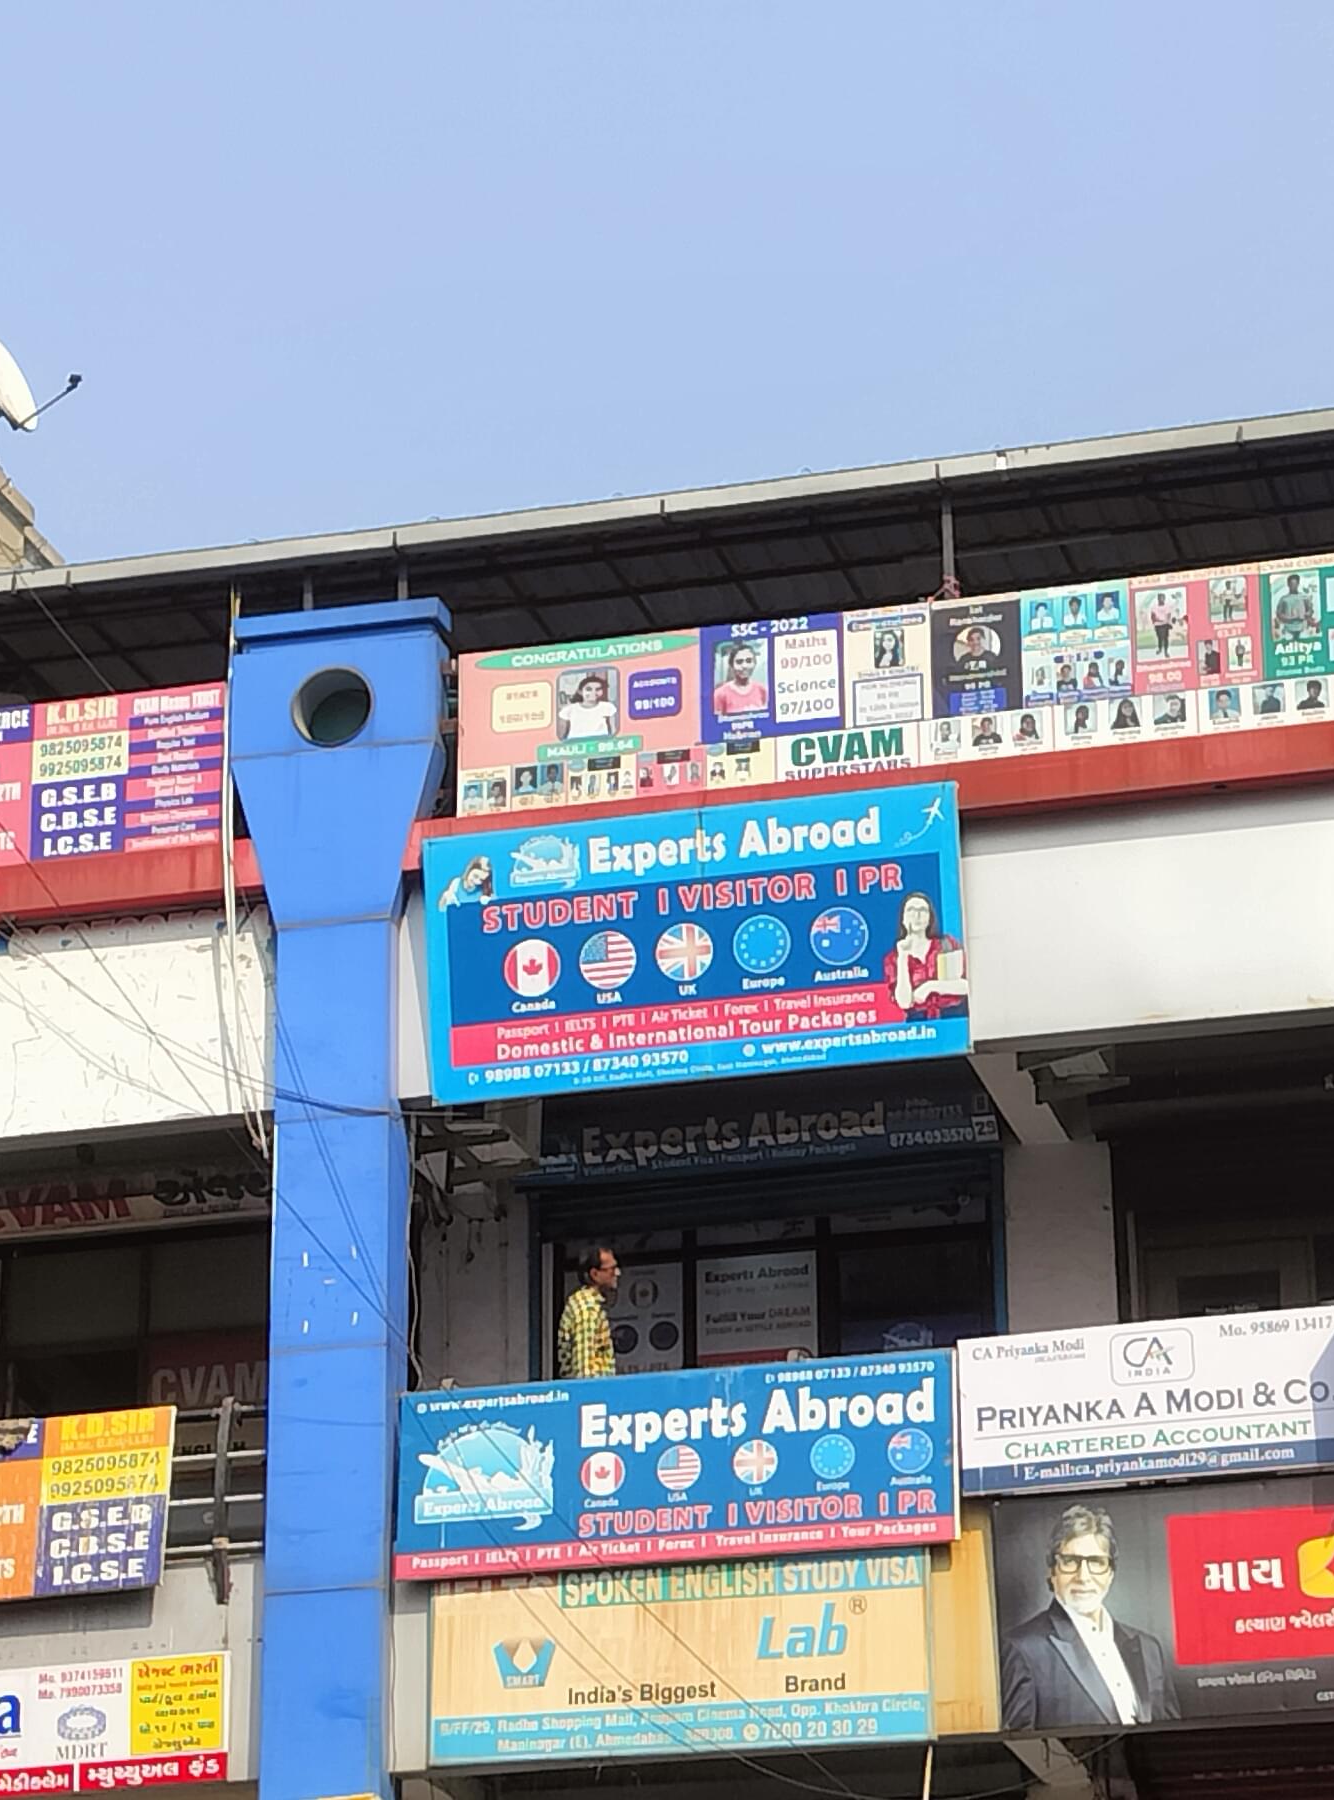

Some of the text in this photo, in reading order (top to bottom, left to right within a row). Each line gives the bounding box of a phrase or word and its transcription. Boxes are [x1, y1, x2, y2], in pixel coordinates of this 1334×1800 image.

[511, 640, 663, 668] CONGRATULATIONS
[785, 636, 827, 650] Maths
[1274, 641, 1322, 656] Aditya
[777, 678, 836, 694] Science
[780, 699, 834, 715] 97/100
[791, 728, 904, 766] CVAM
[785, 759, 911, 781] SUPERSTARS
[41, 782, 117, 807] G.S.E.B
[40, 807, 117, 832] C.B.S.E
[43, 832, 112, 857] I.C.S.E
[589, 807, 881, 877] Experts Abroad
[482, 891, 638, 933] STUDENT
[678, 869, 814, 912] VISITOR
[857, 864, 904, 893] PR
[742, 976, 785, 992] Europe
[815, 967, 869, 983] Australia
[596, 991, 623, 1005] USA
[678, 984, 697, 997] UK
[511, 999, 556, 1014] Canada
[497, 1008, 877, 1060] Domestic & International Tour Packages
[761, 1025, 937, 1058] www.expertsabroad.in
[582, 1115, 741, 1166] Experts
[749, 1101, 886, 1148] Abroad
[972, 1338, 1085, 1361] CA Priyanka Modi
[1128, 1366, 1172, 1378] INDIA
[580, 1377, 935, 1452] Experts Abroad
[977, 1398, 1125, 1432] PRIYANKA
[1134, 1392, 1157, 1417] A
[1252, 1382, 1276, 1406] &
[60, 1411, 154, 1441] K.D.SIR
[1005, 1420, 1312, 1460] CHARTERED ACCOUNTANT
[51, 1503, 151, 1532] G.S.E.B
[579, 1504, 712, 1538] STUDENT
[745, 1495, 863, 1525] VISITOR
[898, 1490, 937, 1514] PR
[50, 1531, 149, 1559] C.B.S.E
[52, 1561, 143, 1587] I.C.S.E
[566, 1555, 920, 1607] SPOKEN ENGLISH STUDY VISA
[1203, 1556, 1284, 1592] માય
[757, 1600, 848, 1660] Lab
[1235, 1616, 1286, 1634] કલ્યાણ
[568, 1681, 717, 1706] India's Biggest
[785, 1673, 846, 1693] Brand
[56, 1741, 107, 1760] MDRT
